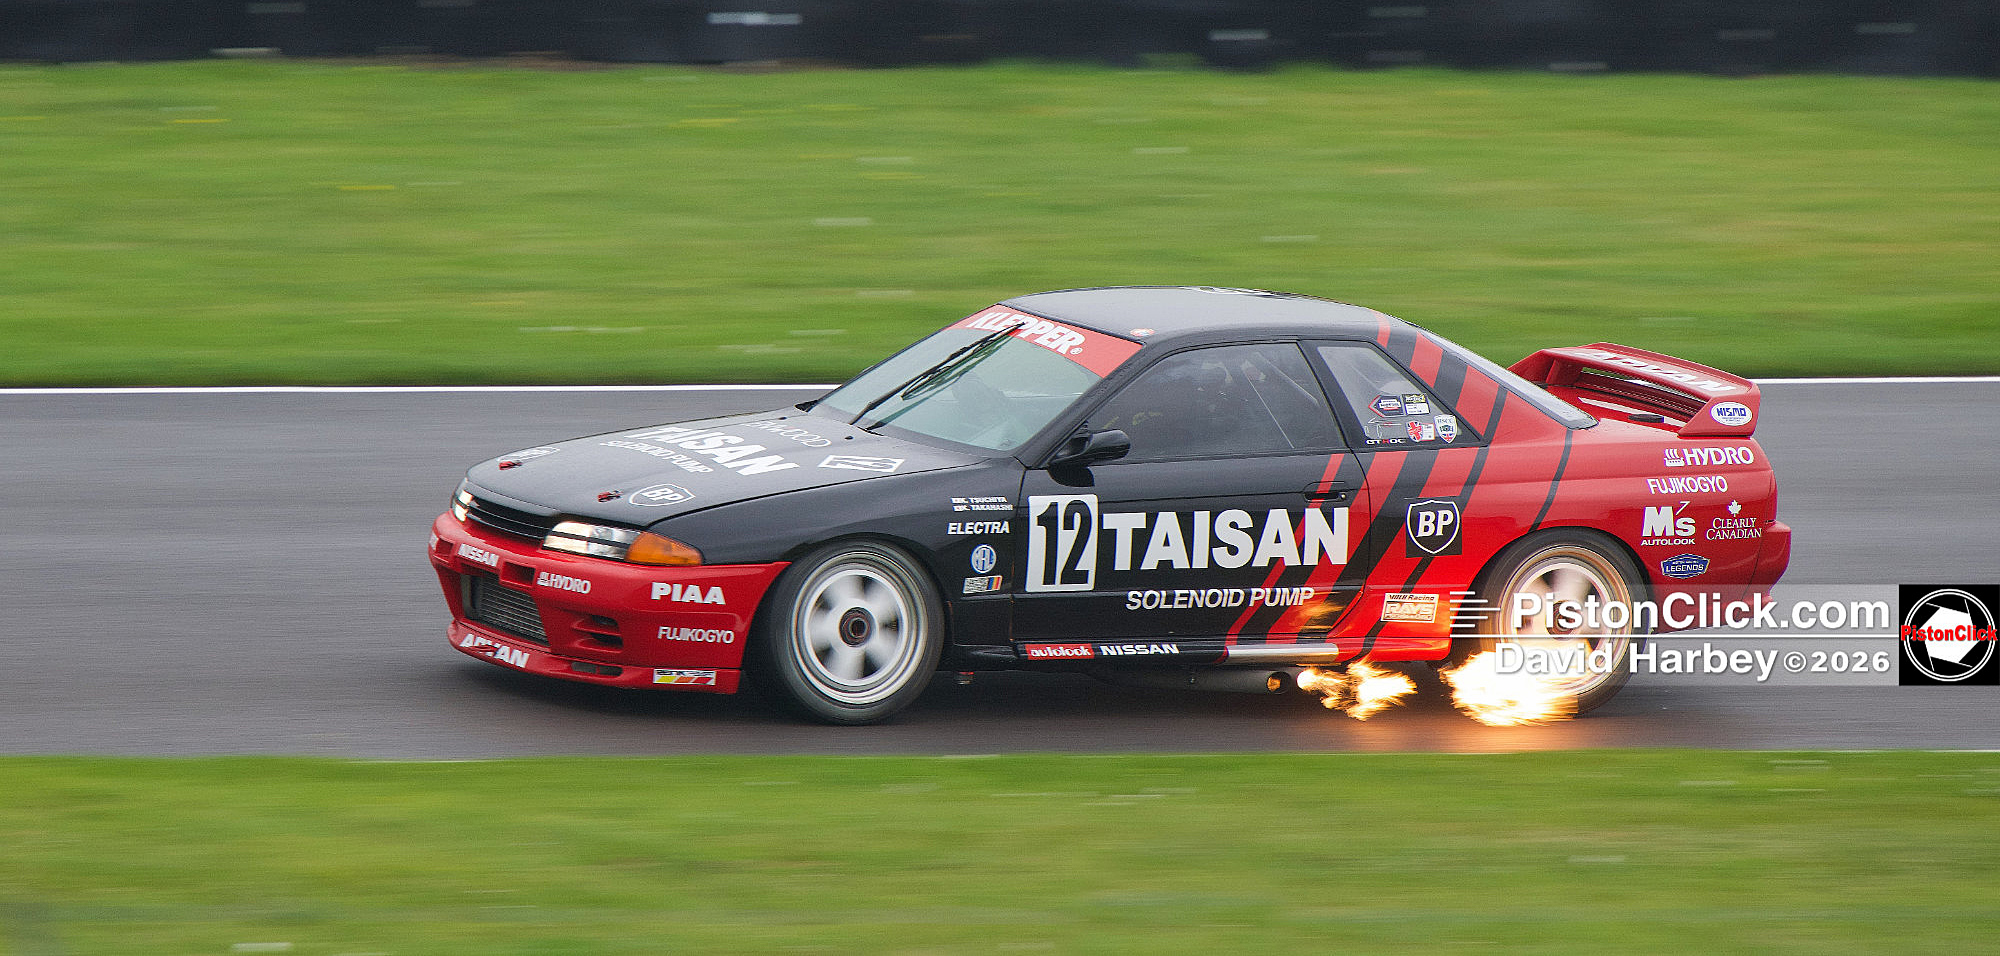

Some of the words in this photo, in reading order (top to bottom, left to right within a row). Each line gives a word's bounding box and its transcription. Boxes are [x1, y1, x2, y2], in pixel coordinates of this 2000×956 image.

[1575, 352, 1737, 392] ADVAN
[1716, 407, 1747, 417] NISMO
[624, 426, 800, 476] TAISAN
[1682, 446, 1754, 466] HYDRO
[662, 454, 714, 473] PUMP
[641, 487, 685, 501] BP
[1646, 475, 1728, 494] FUJIKOGYO
[947, 521, 1011, 535] ELECTRA
[1415, 509, 1454, 538] BP
[1712, 517, 1757, 529] CLEARLY
[1034, 499, 1093, 587] 12
[1102, 506, 1350, 571] TAISAN
[1640, 538, 1696, 546] AUTOLOOK
[1706, 528, 1763, 541] CANADIAN
[457, 543, 499, 567] NISSAN
[1665, 564, 1704, 572] LEGENDS
[549, 573, 592, 594] HYDRO
[651, 581, 727, 605] PIAA
[1125, 588, 1246, 611] SOLENOID
[1248, 587, 1315, 607] PUMP
[657, 626, 735, 644] FUJIKOGYO
[1100, 643, 1180, 656] NISSAN
